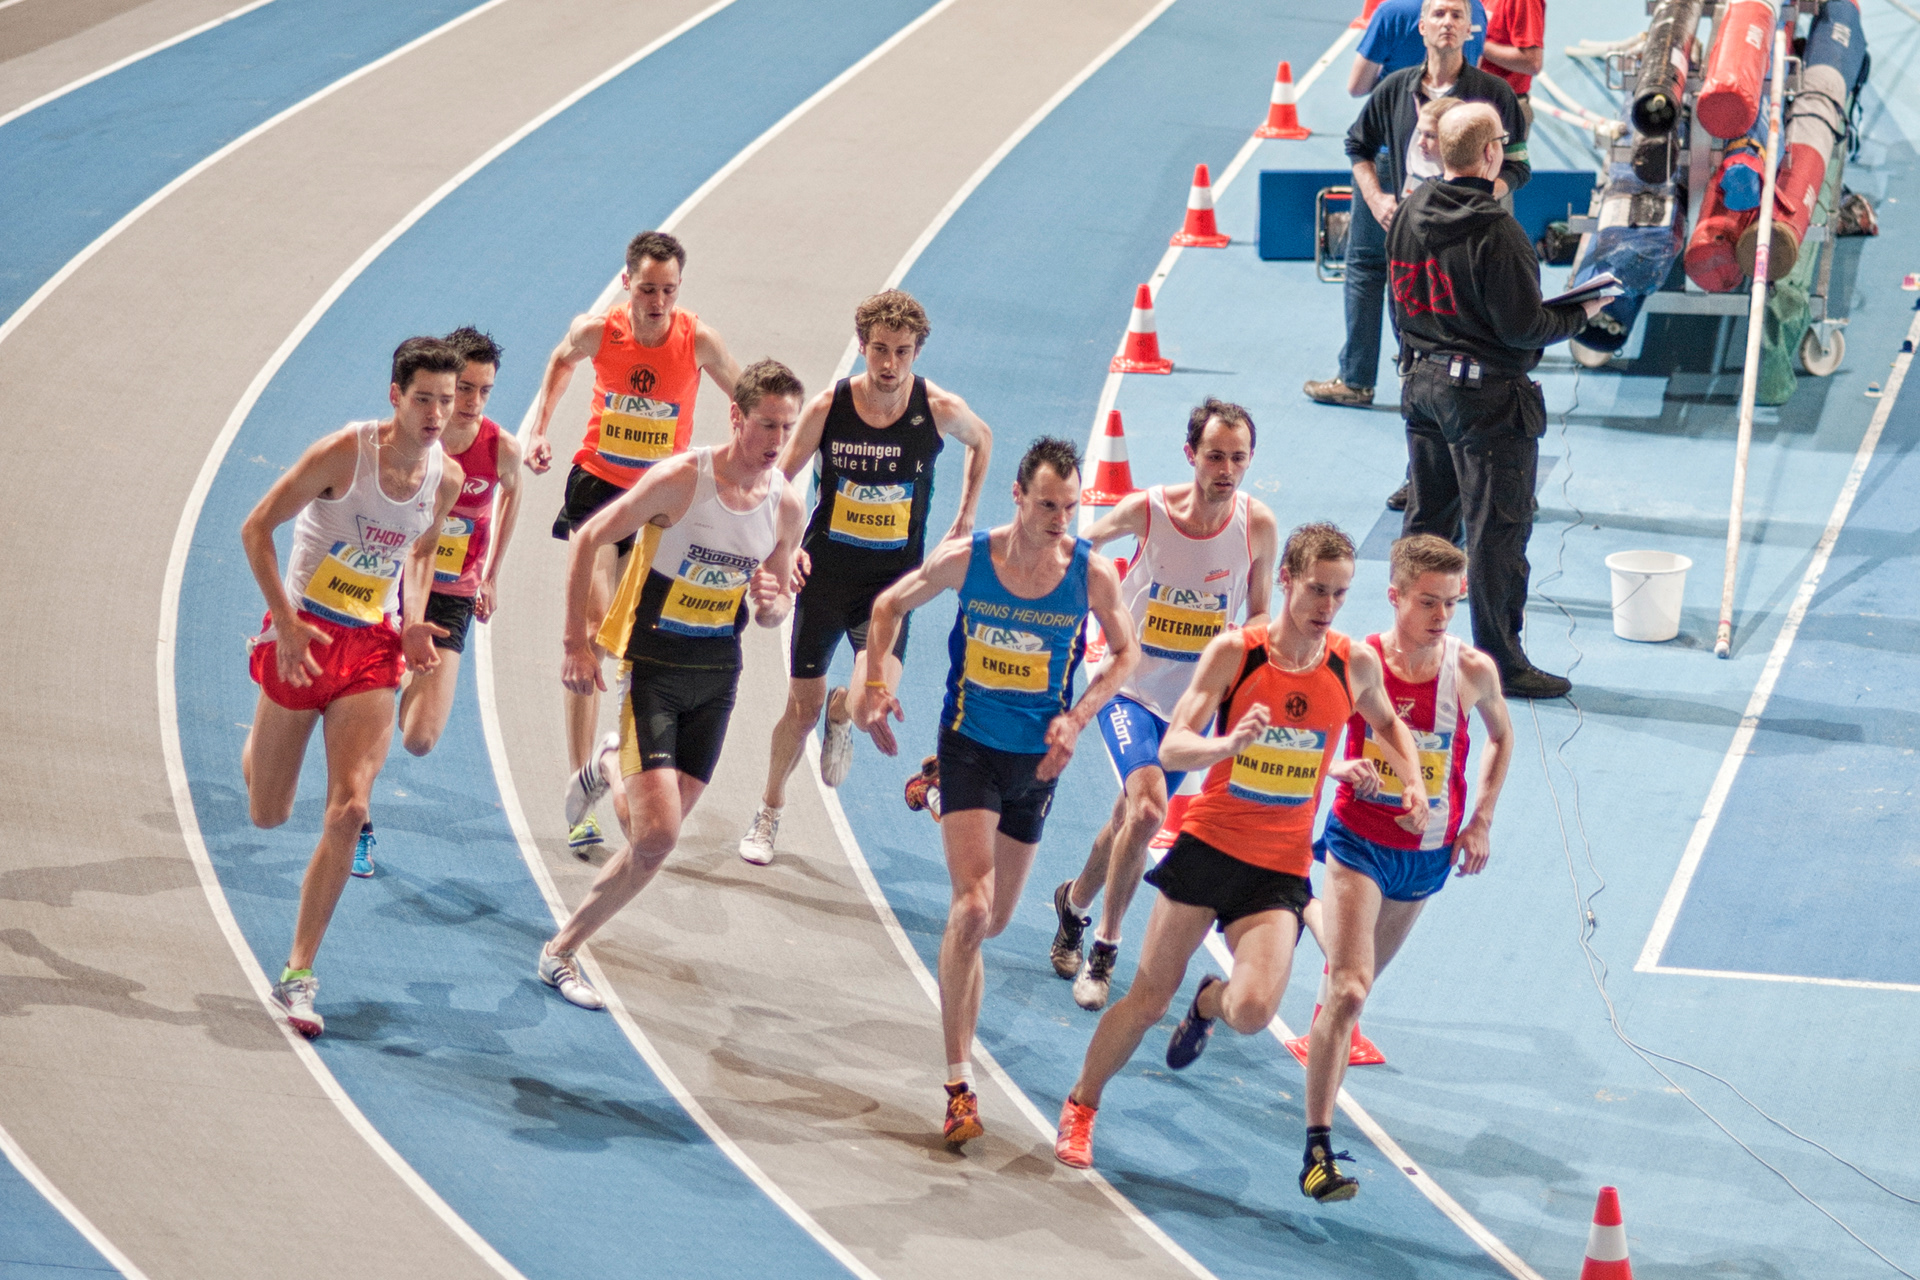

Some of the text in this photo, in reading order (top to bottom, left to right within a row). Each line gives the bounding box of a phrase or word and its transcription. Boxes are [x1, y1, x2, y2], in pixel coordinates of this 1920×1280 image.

[606, 424, 668, 445] DE RUITER
[831, 441, 902, 459] groningen
[846, 510, 896, 526] WESSEL
[365, 526, 406, 547] THOR
[328, 576, 374, 602] NOUWS
[967, 599, 1078, 627] PRINS HENDRIK
[1148, 615, 1222, 637] PIETERMAN
[982, 656, 1031, 677] ENGELS
[1236, 754, 1318, 779] VAN DER PARK
